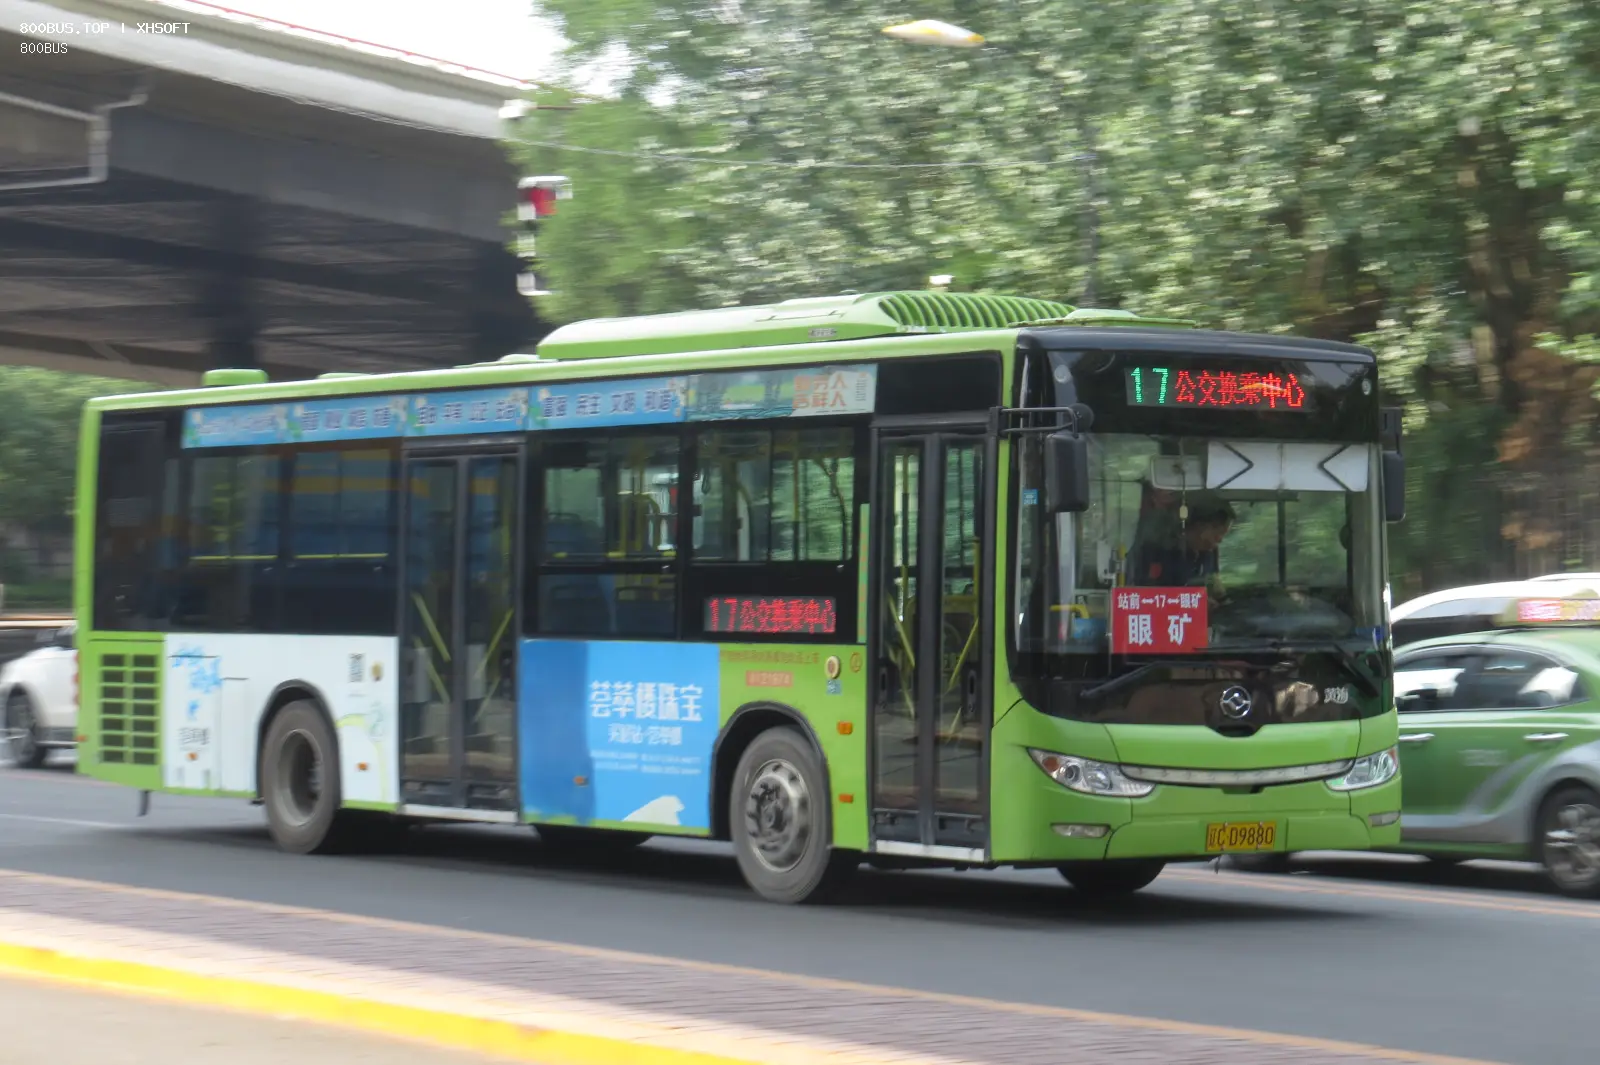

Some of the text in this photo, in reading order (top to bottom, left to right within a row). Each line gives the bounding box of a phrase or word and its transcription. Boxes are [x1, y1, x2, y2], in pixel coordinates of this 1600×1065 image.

[1130, 367, 1168, 404] 17
[1174, 369, 1305, 408] 公交换乘中心
[1117, 592, 1202, 610] 站前 17 眼矿
